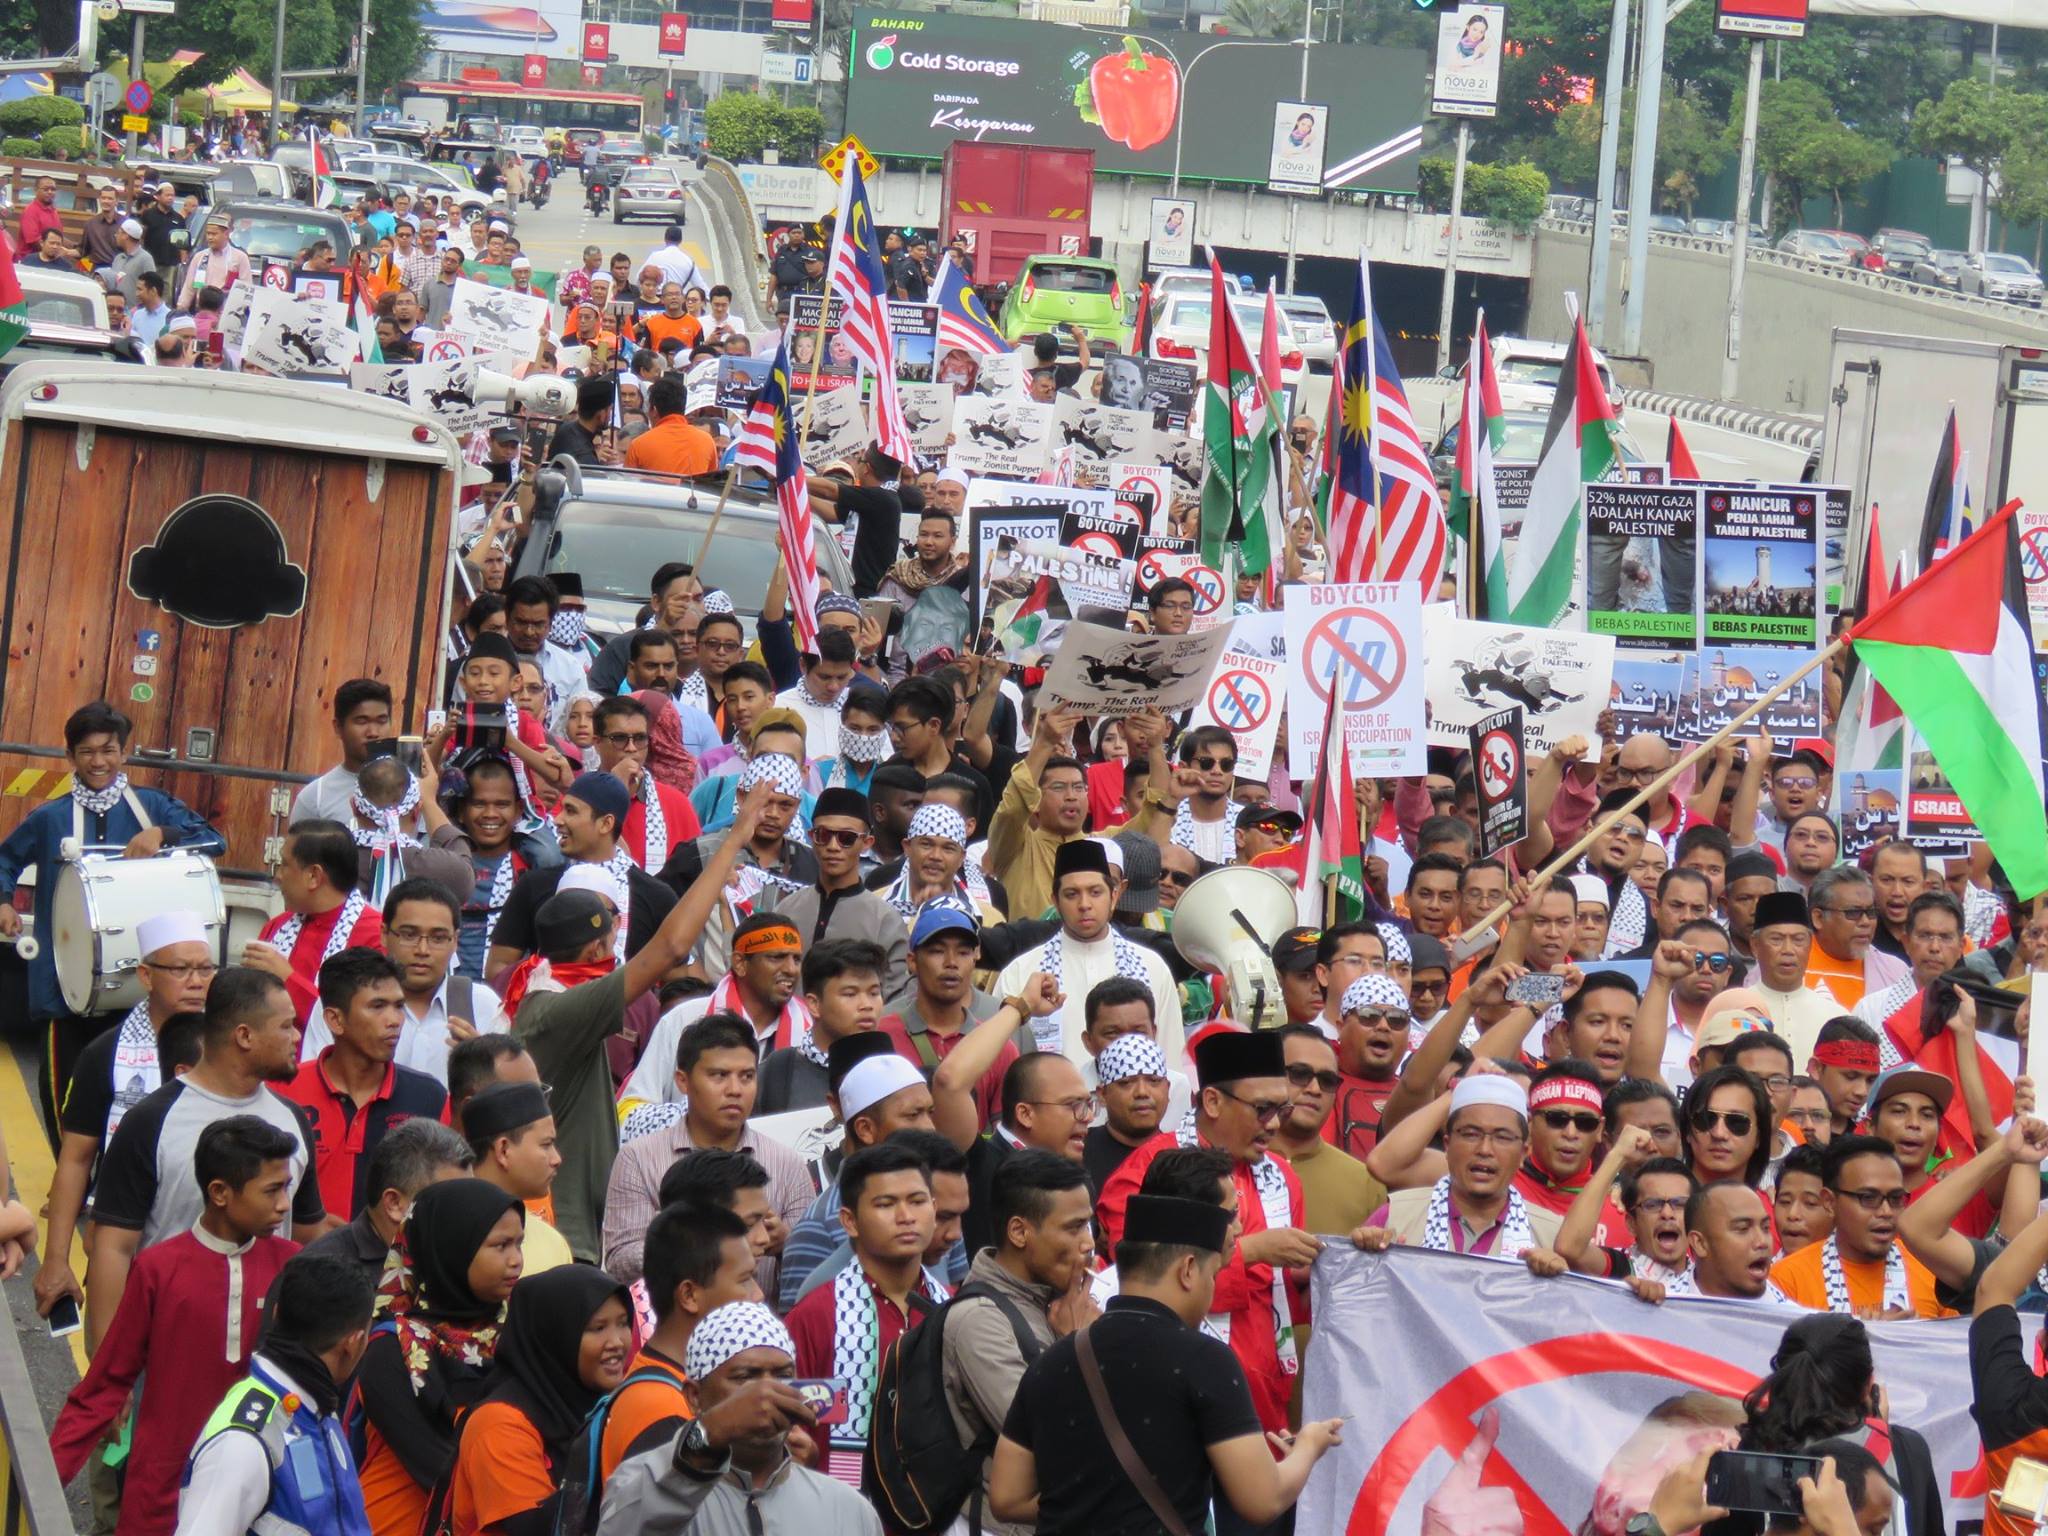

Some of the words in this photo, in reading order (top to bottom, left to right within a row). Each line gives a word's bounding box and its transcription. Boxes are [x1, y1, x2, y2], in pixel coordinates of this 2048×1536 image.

[871, 18, 925, 31] BAHARU
[900, 52, 940, 70] Cold
[945, 55, 1019, 76] Storage
[1444, 76, 1475, 88] nova
[1478, 79, 1488, 88] 2i
[933, 94, 979, 104] DARIPADA
[930, 108, 1035, 141] Kesegaran
[1278, 161, 1304, 171] nova
[1470, 230, 1506, 239] LUMPUR
[1474, 240, 1501, 249] CERIA
[825, 320, 840, 328] ZIO
[896, 326, 931, 335] PALESTINE
[435, 332, 467, 342] BOYCOTT
[791, 376, 803, 384] TO
[805, 377, 826, 386] HLL
[448, 422, 471, 434] ionist
[820, 444, 837, 456] Real
[918, 444, 947, 453] Puppet
[985, 452, 999, 460] The
[1001, 455, 1018, 463] Real
[983, 461, 1010, 470] Zionist
[1075, 461, 1090, 472] The
[1091, 463, 1109, 473] Real
[1123, 465, 1162, 476] BOYCOTT
[1494, 469, 1528, 479] ZIONIST
[1116, 491, 1145, 502] YCOTT
[1185, 491, 1200, 500] Rea
[1502, 488, 1529, 496] WORLD
[1588, 492, 1615, 504] 52%
[1618, 494, 1660, 507] RAKYAT
[1661, 495, 1694, 507] GAZA
[1730, 496, 1791, 512] HANCUR
[1589, 506, 1643, 520] ADALAH
[1826, 509, 1847, 517] MEDIA
[2024, 513, 2048, 525] BOYC
[1077, 516, 1128, 535] BOYCOTT
[1609, 522, 1675, 536] PALESTINE
[982, 525, 1056, 540] BOIKOT
[1715, 525, 1750, 537] TANAH
[1752, 526, 1807, 539] PALESTINE
[1143, 538, 1186, 549] BOYCOTT
[1085, 553, 1121, 570] FREE
[1008, 550, 1120, 591] PALESTINE
[1310, 585, 1399, 605] BOYCOTT
[1595, 618, 1630, 629] BEBAS
[1633, 620, 1691, 632] PALESTINE
[1712, 621, 1747, 632] BEBAS
[1751, 623, 1808, 635] PALESTINE
[1222, 653, 1277, 674] BOYCOTT
[1104, 697, 1129, 706] The
[1132, 695, 1159, 705] Real
[1610, 682, 1671, 714] القد
[1098, 705, 1143, 714] Zionist
[1344, 714, 1374, 728] NSOR
[1377, 714, 1390, 727] OF
[1477, 710, 1513, 737] BOYCOTT
[1767, 707, 1816, 729] عاصمة
[1433, 720, 1470, 736] Trum
[1524, 724, 1545, 737] eal
[1914, 801, 1963, 816] ISRAEL
